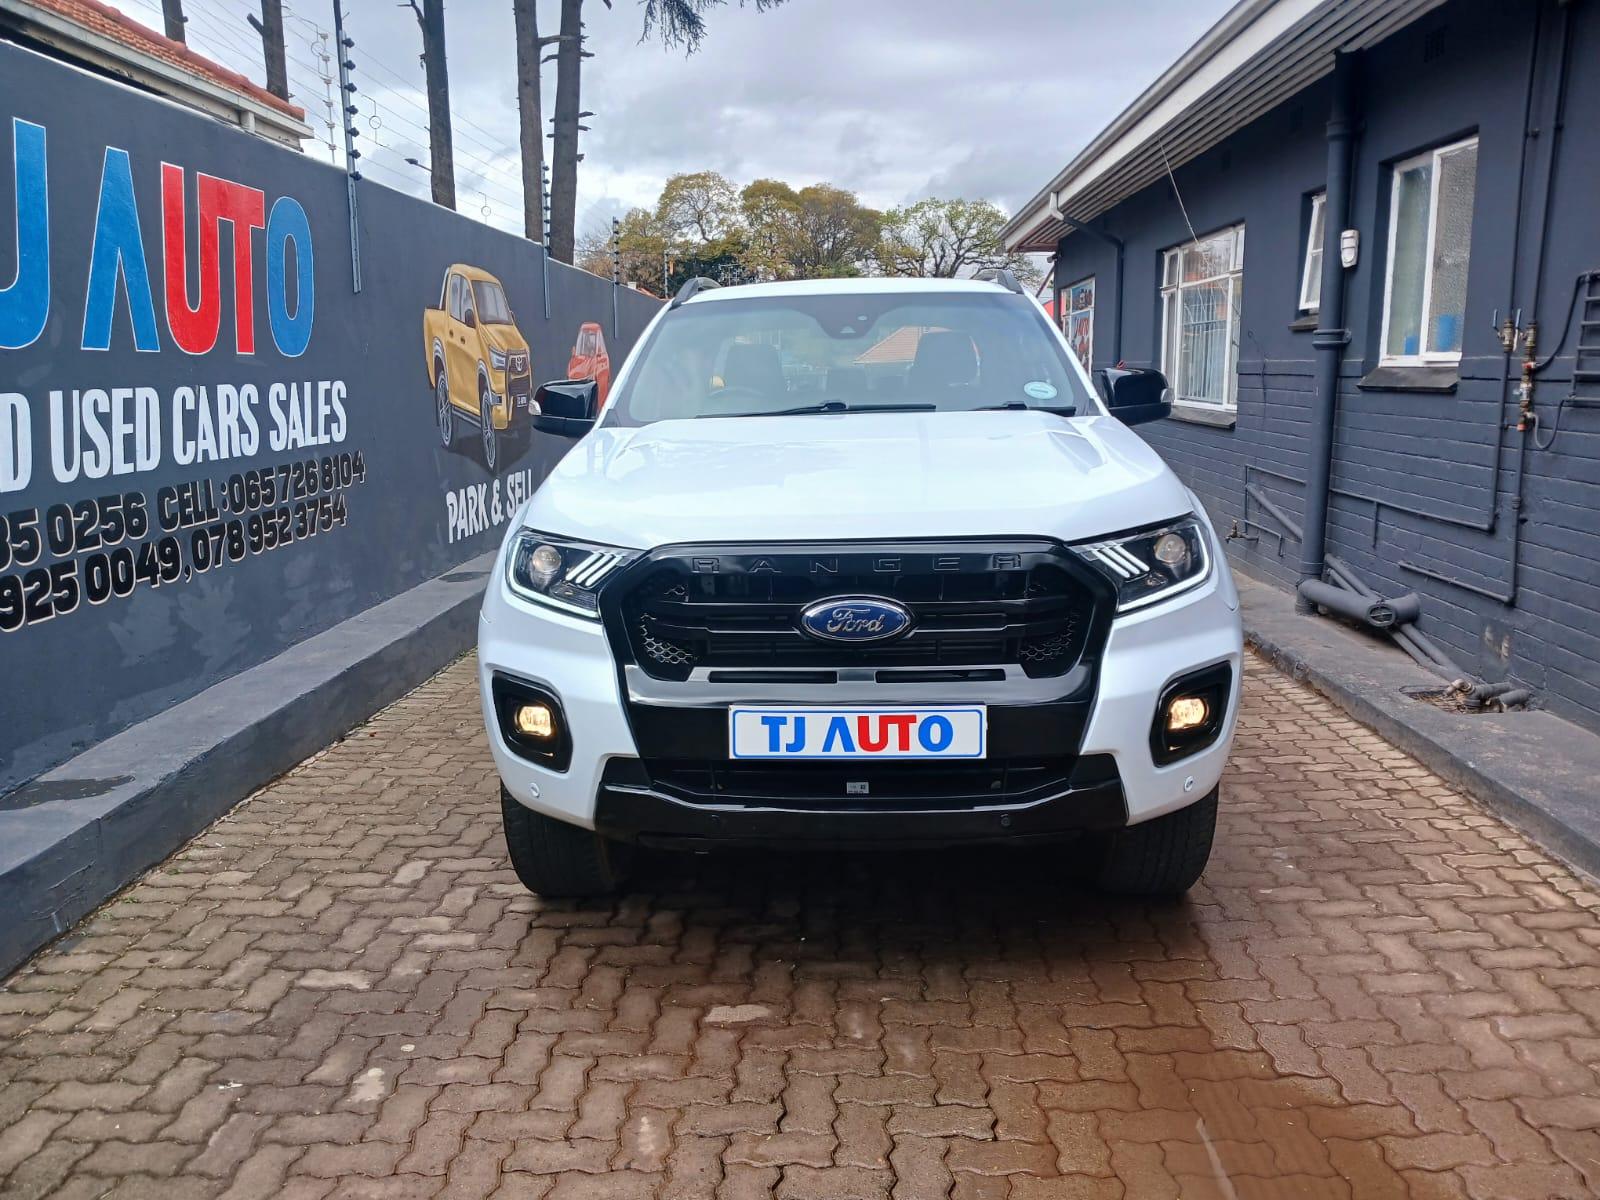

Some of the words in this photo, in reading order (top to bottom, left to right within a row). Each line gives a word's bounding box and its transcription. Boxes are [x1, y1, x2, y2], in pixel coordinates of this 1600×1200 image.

[81, 146, 315, 358] AUTO
[49, 386, 162, 483] USED
[172, 383, 260, 466] CARS
[268, 379, 348, 449] SALES
[46, 491, 149, 558] 0256
[278, 458, 320, 504] 726
[320, 450, 366, 493] 8104
[248, 506, 294, 555] 952
[294, 492, 348, 540] 3754
[446, 482, 490, 544] PARK
[491, 478, 505, 526] &
[691, 553, 1023, 574] RANGER
[826, 607, 887, 633] Ford
[760, 715, 806, 753] TJ
[821, 714, 954, 753] AUTO
